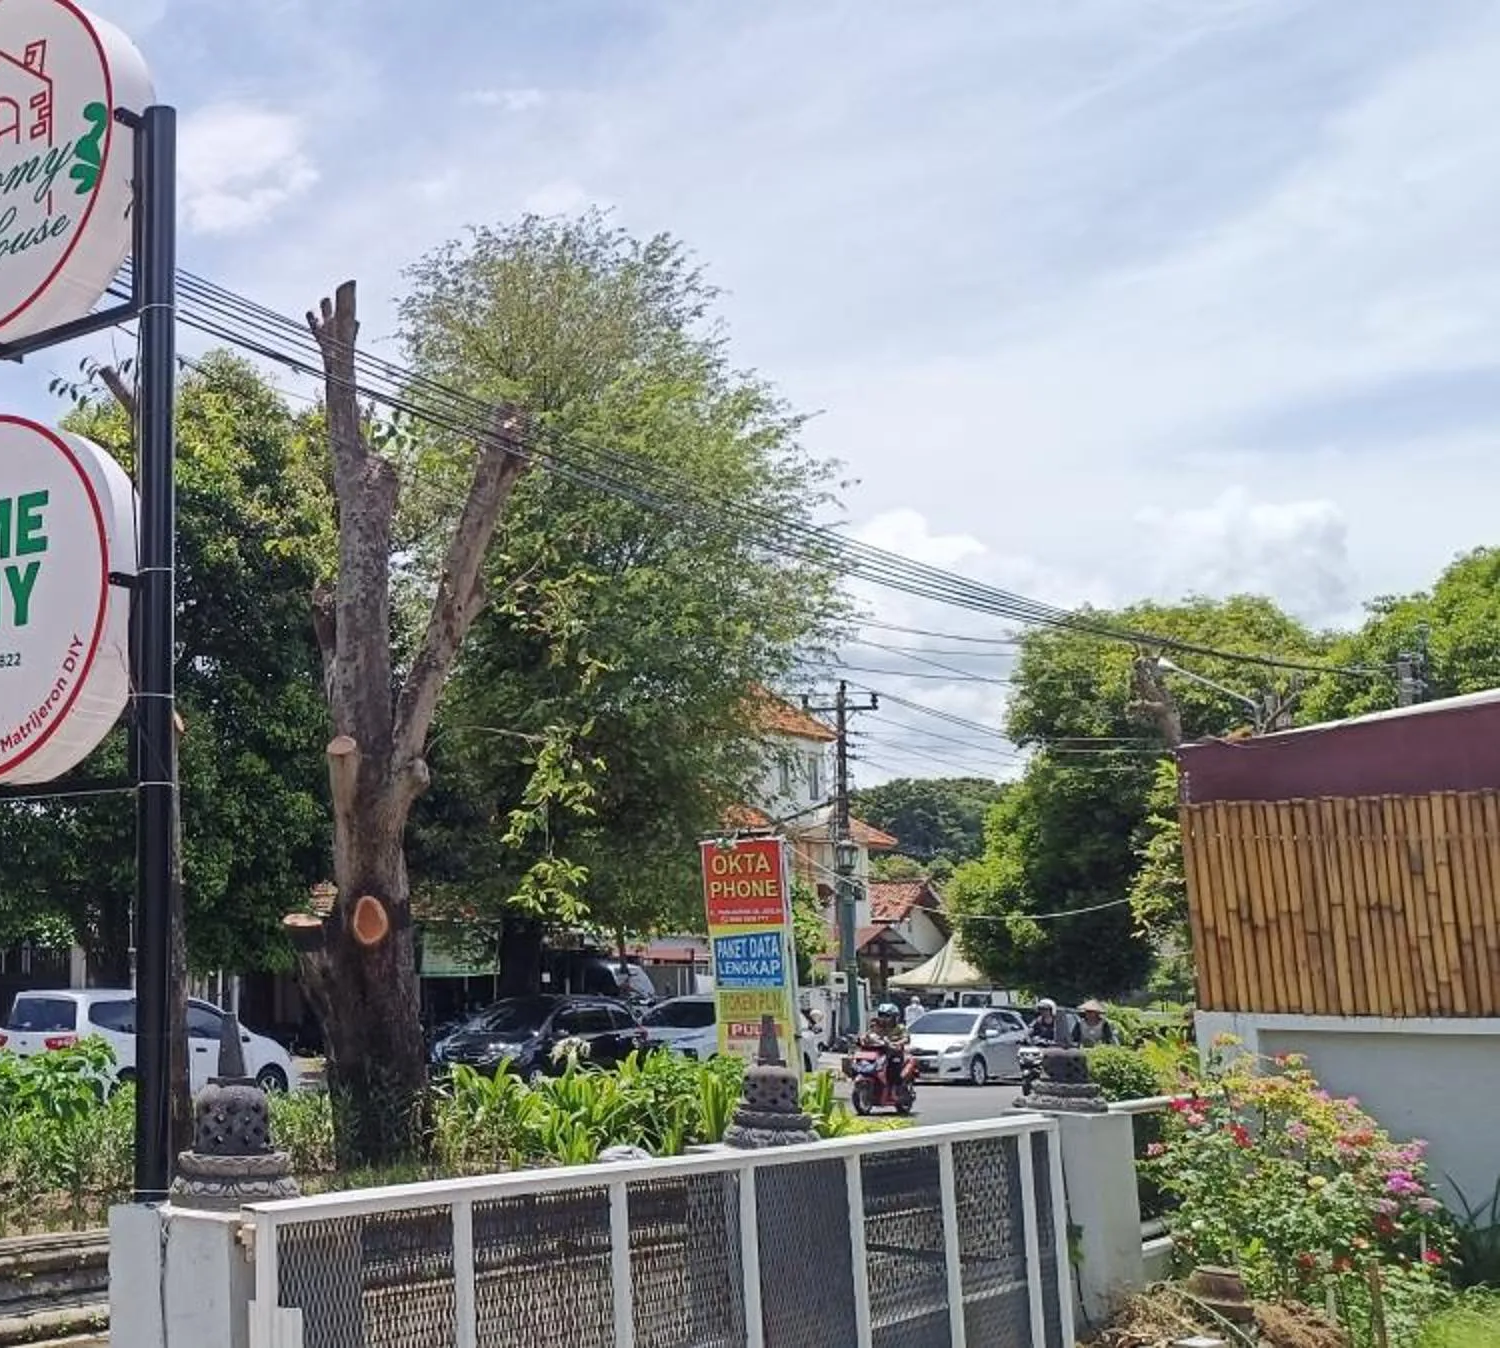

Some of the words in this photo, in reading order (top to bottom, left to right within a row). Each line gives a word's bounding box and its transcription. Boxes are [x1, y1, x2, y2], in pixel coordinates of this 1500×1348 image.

[0, 677, 67, 753] Matrijeron
[62, 633, 83, 673] DIY
[711, 853, 771, 876] OKTA
[710, 879, 779, 899] PHONE
[717, 938, 748, 959] PAKET
[749, 935, 780, 958] DATA
[718, 959, 781, 975] LENGKAP
